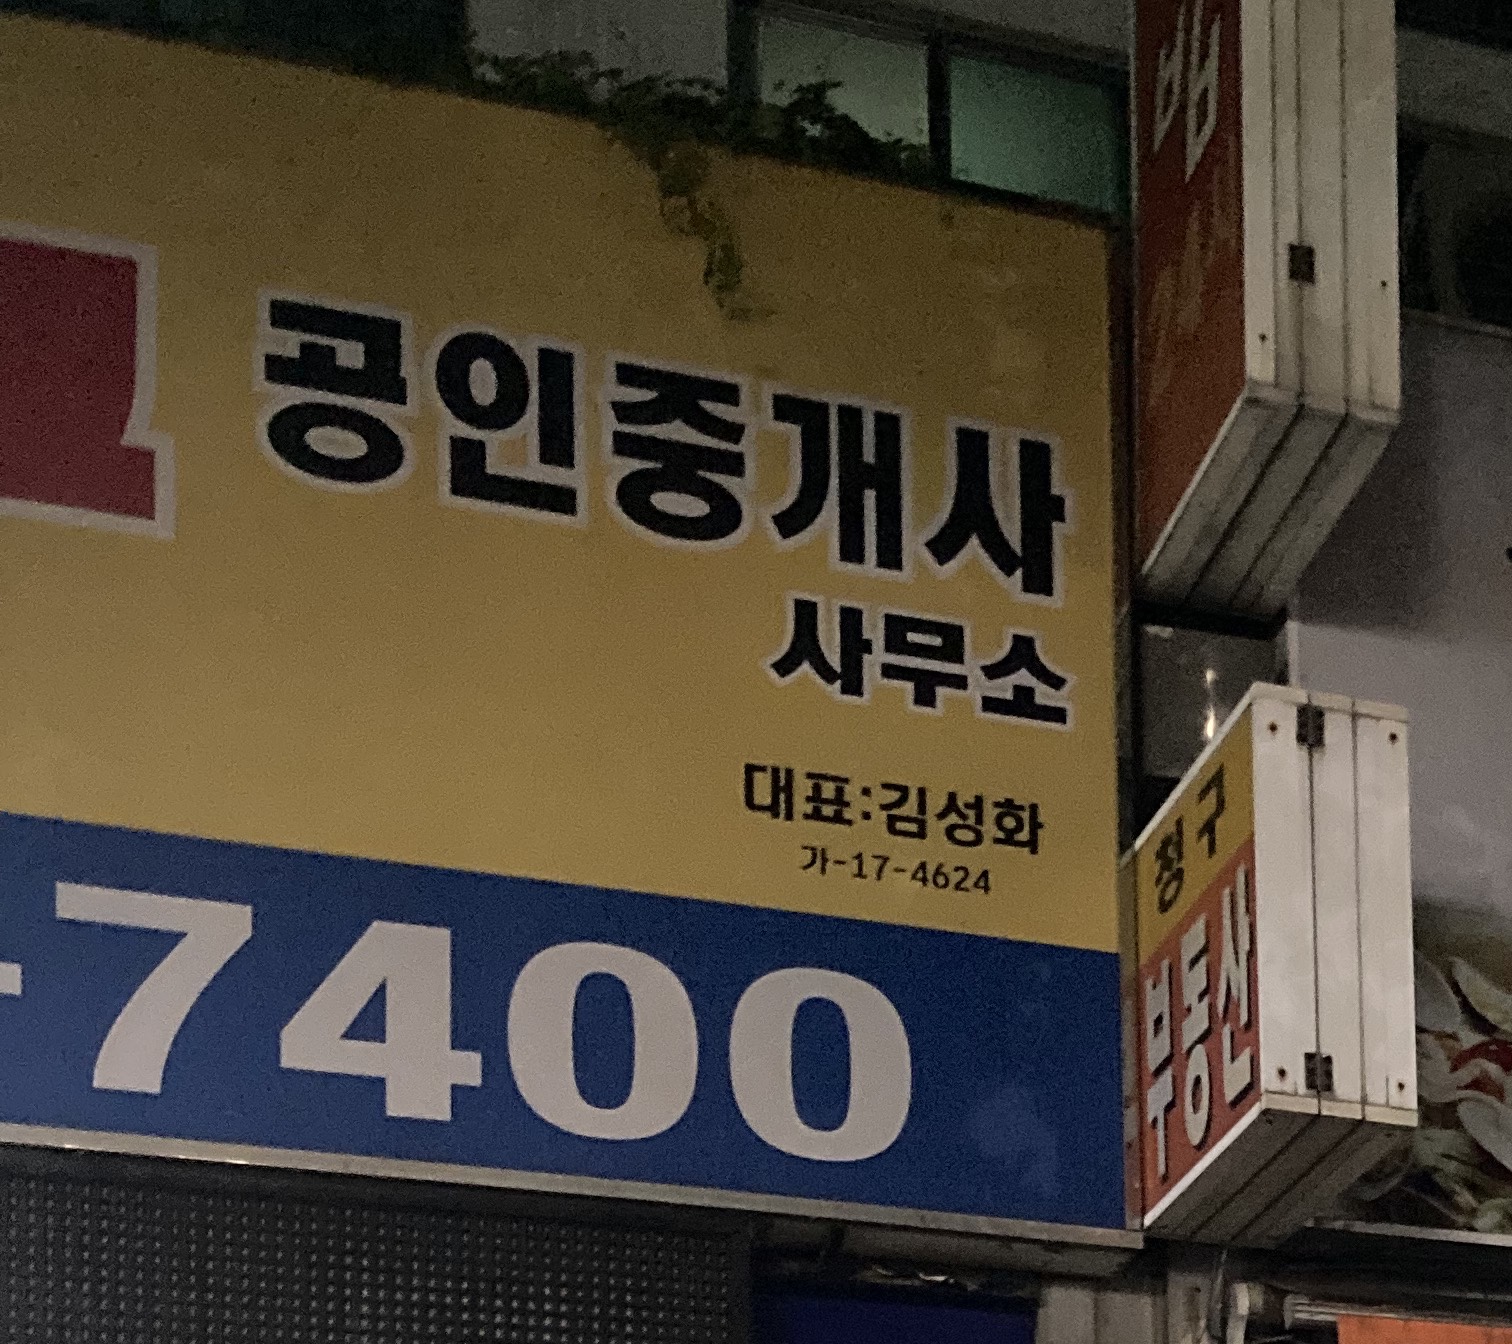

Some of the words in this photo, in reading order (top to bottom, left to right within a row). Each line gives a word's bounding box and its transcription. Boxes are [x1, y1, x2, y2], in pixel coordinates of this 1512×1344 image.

[260, 292, 1070, 600] 공인중개사
[768, 594, 1076, 728] 사무소
[742, 762, 1045, 856] 대표:김성화
[799, 845, 994, 897] 가-17-4624
[1154, 763, 1228, 914] 청구
[1144, 862, 1255, 1183] 부동산
